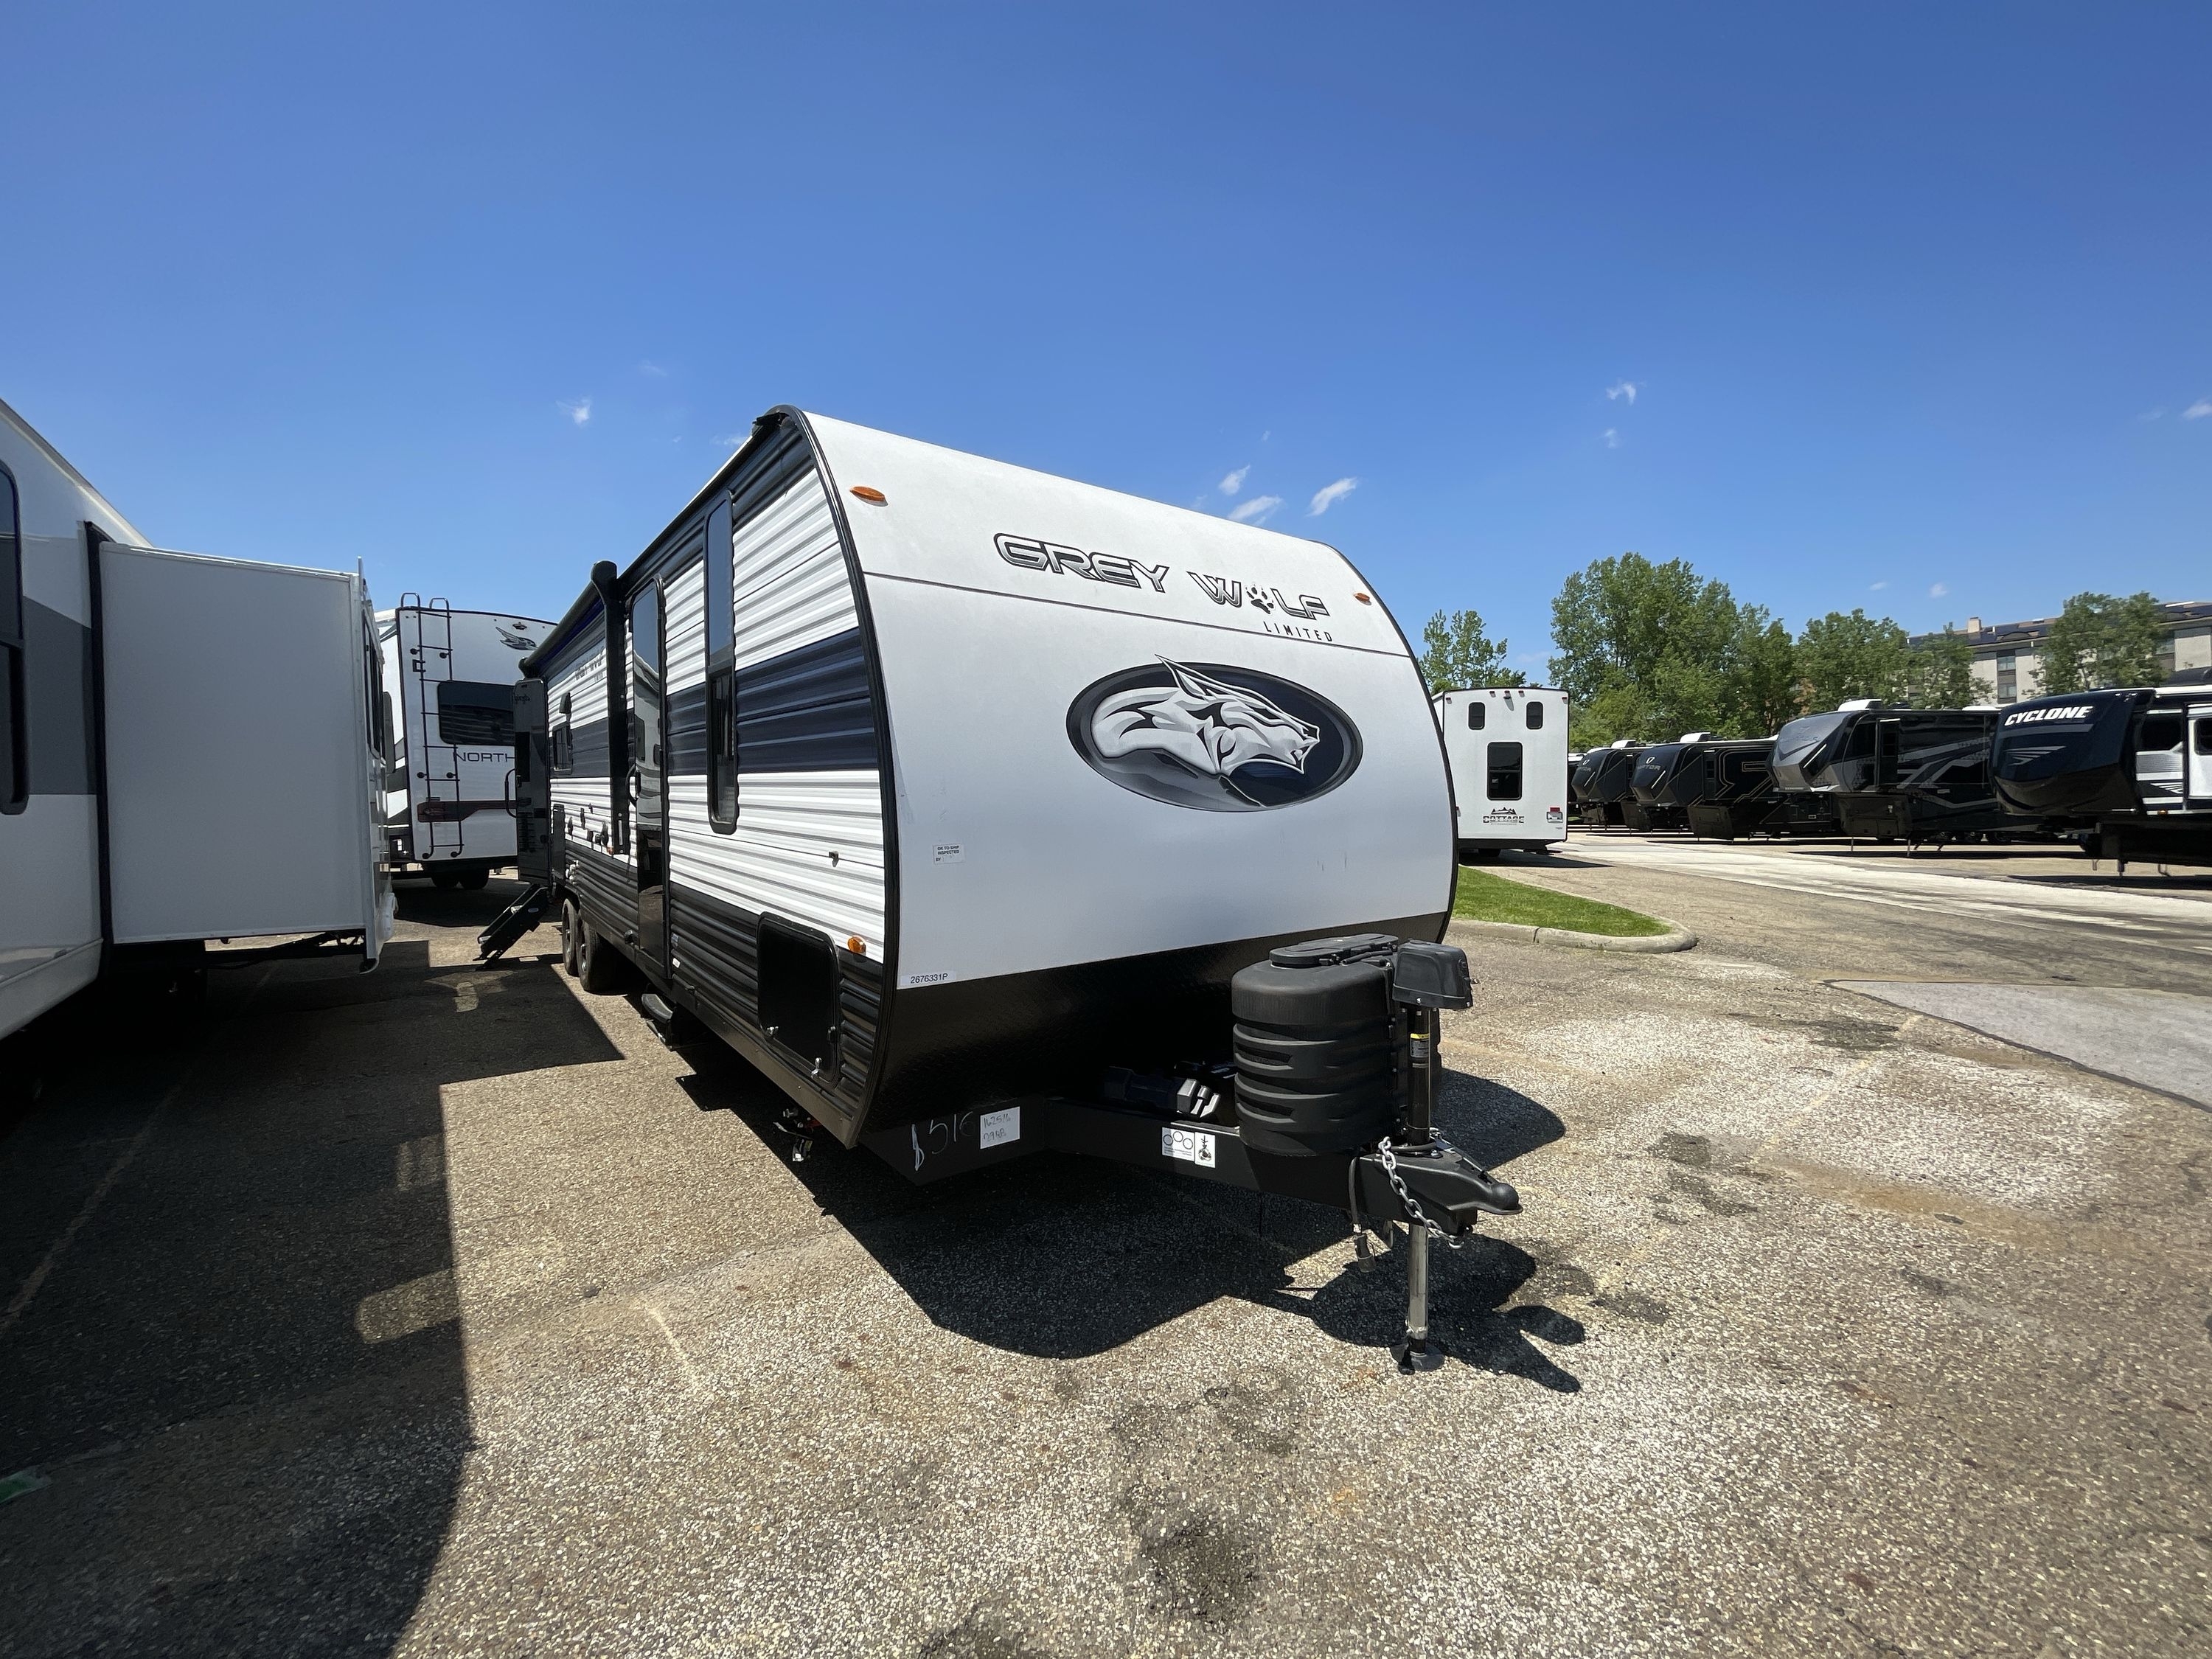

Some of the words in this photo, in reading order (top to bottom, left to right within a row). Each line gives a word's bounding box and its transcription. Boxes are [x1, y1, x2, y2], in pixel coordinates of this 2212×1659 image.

[993, 532, 1170, 594] GREY
[1263, 621, 1332, 641] LIMITED
[2004, 706, 2094, 726] CYCLONE
[1483, 815, 1524, 824] COTTAGE
[910, 973, 948, 984] 2676331P
